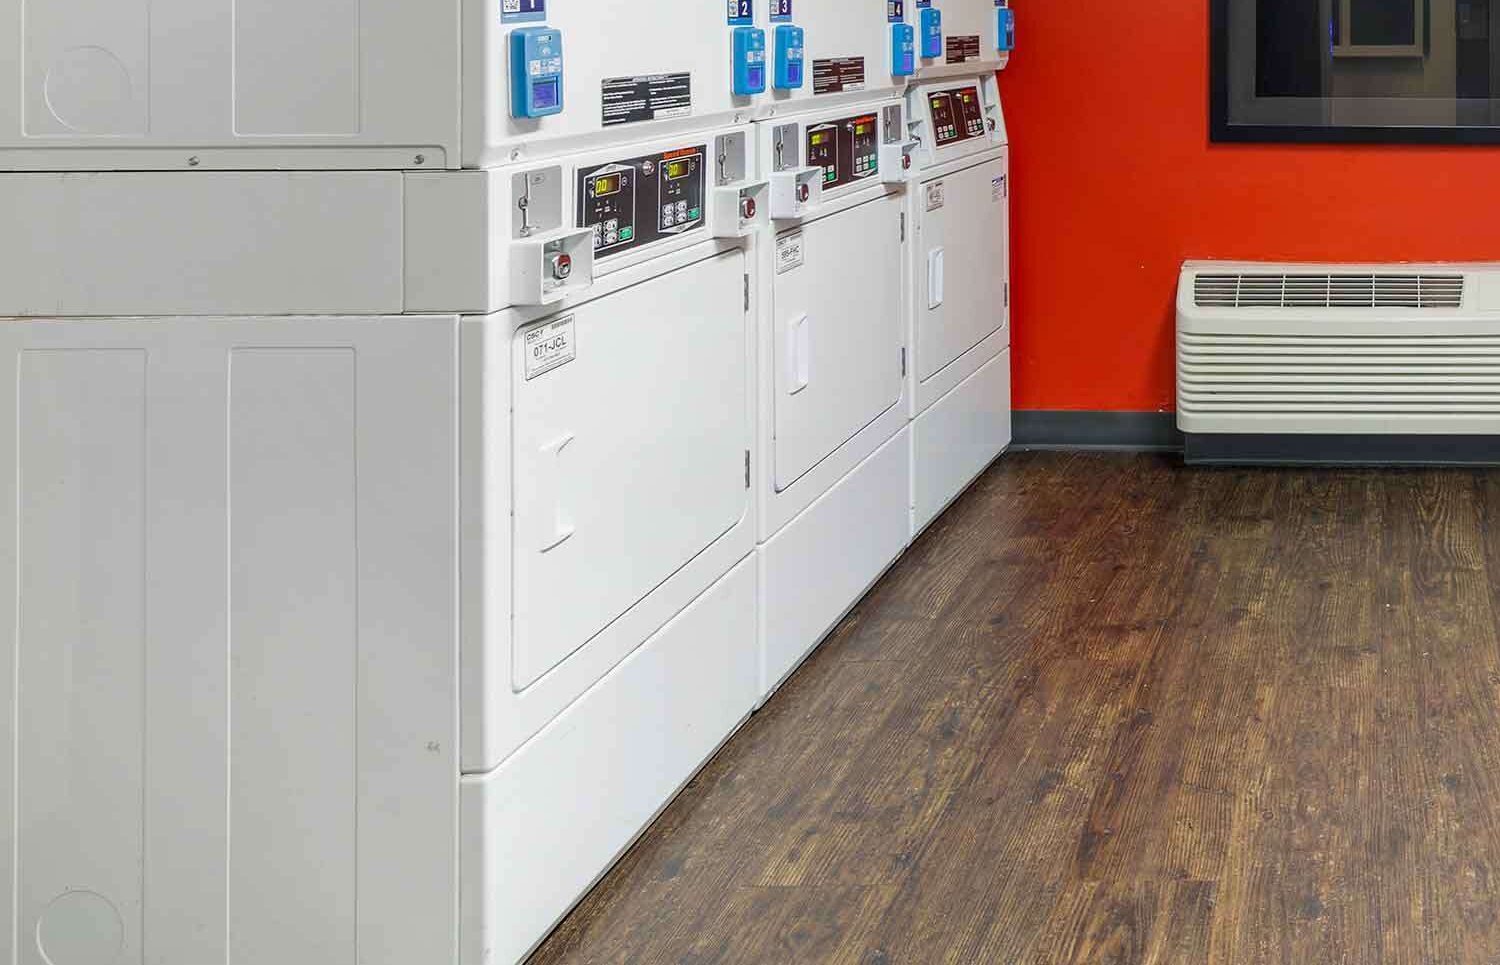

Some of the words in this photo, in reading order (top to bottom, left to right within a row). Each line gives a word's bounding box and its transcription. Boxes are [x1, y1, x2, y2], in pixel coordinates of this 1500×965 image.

[742, 1, 748, 15] 2
[782, 0, 788, 13] 3
[896, 3, 901, 16] 4
